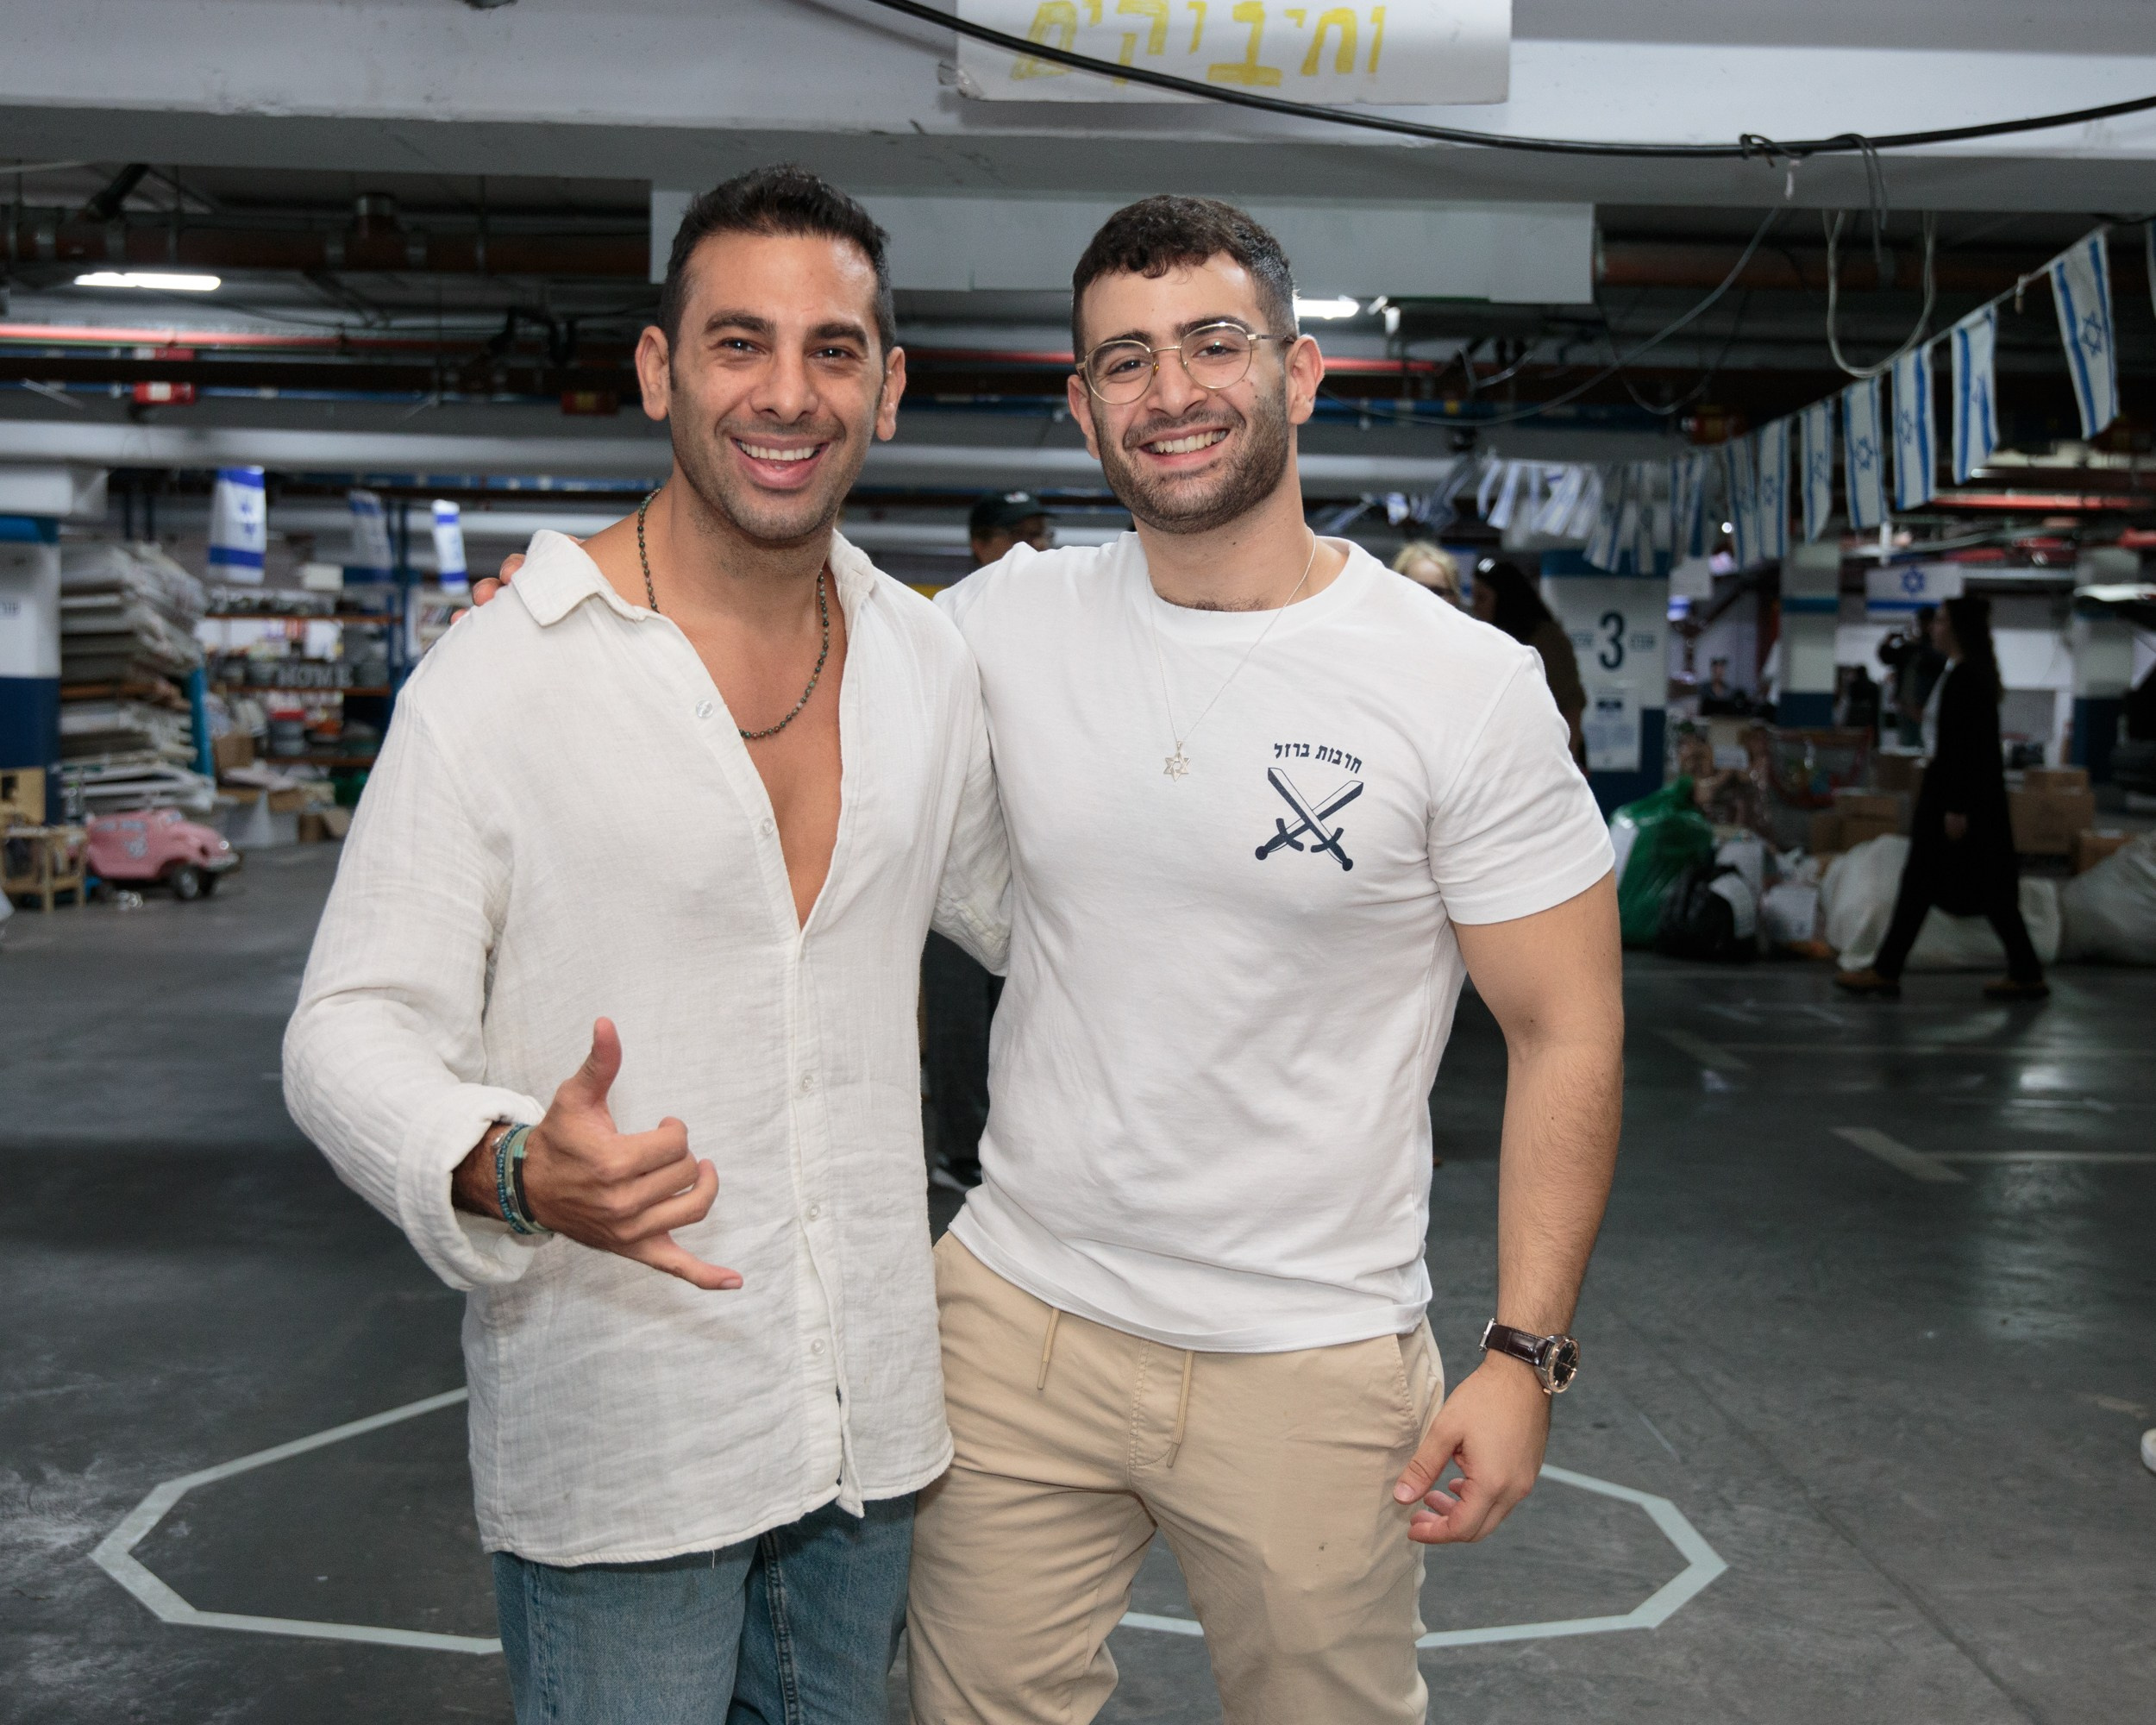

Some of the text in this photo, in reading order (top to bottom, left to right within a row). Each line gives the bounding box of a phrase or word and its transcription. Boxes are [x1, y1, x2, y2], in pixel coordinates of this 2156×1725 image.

[1010, 0, 1387, 88] וחיבוקים
[1600, 611, 1625, 670] 3
[1274, 743, 1363, 775] חרבות ברזל
